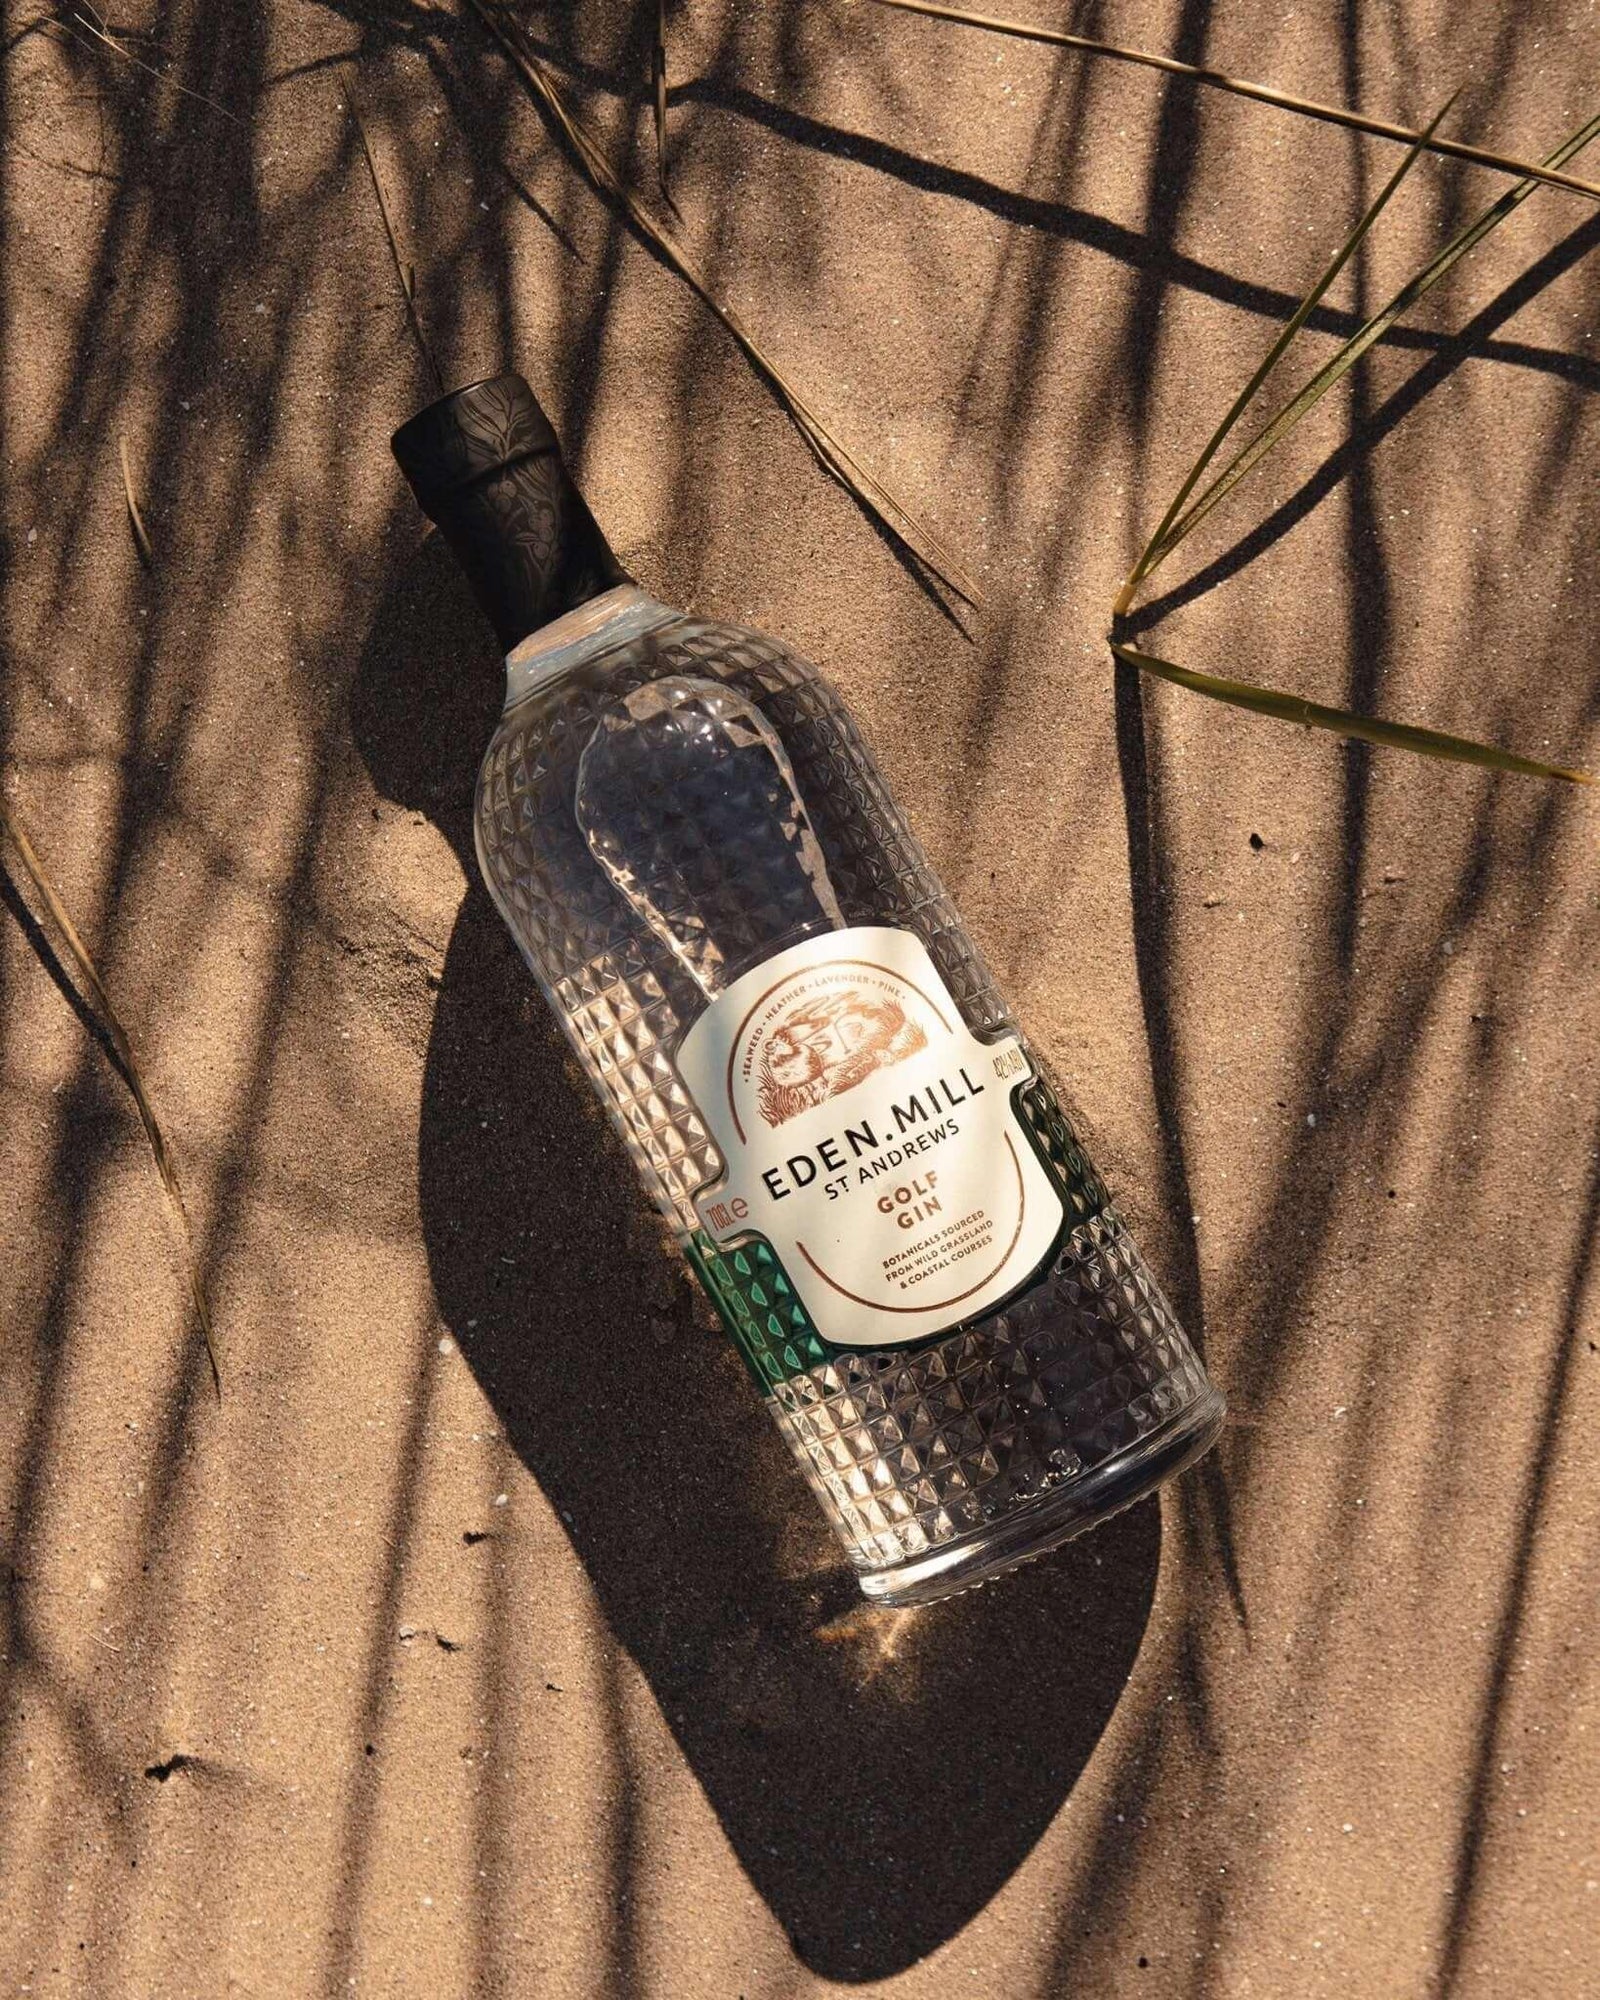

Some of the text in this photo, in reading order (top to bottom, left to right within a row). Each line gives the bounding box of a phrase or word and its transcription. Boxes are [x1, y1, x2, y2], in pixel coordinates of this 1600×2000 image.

[742, 974, 901, 1076] SEAWEED HEATHER LAVENDER PINE
[858, 1118, 960, 1184] ANDREWS
[877, 1170, 938, 1214] GOLF
[897, 1196, 943, 1229] GIN
[882, 1210, 985, 1269] BOTANICALS SOURCED
[885, 1219, 994, 1282] FROM WILD GRASSLAND
[899, 1234, 993, 1290] & COASTAL COURSES
